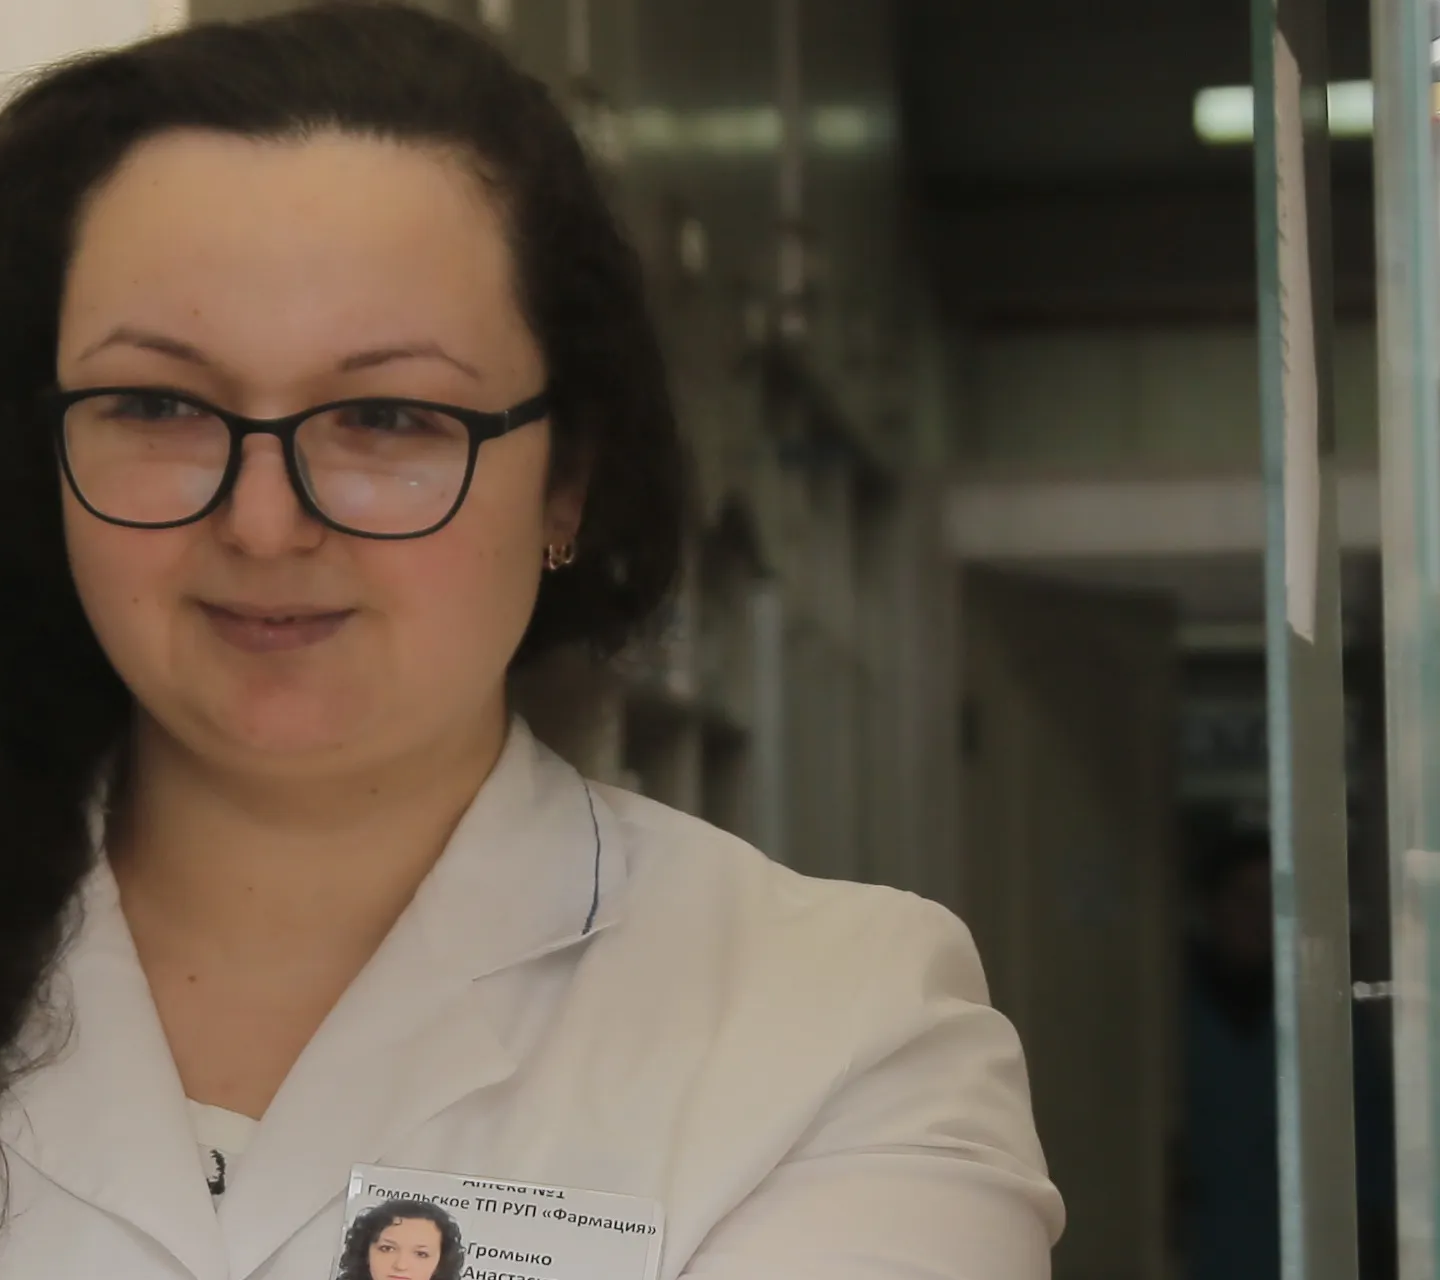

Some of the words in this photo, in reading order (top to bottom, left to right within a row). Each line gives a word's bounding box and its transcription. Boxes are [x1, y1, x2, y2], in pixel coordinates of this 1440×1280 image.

[367, 1183, 470, 1211] Гомельское
[474, 1197, 497, 1214] ТП
[502, 1201, 538, 1219] РУП
[541, 1205, 658, 1237] «Фармация»
[466, 1241, 554, 1268] Громыко
